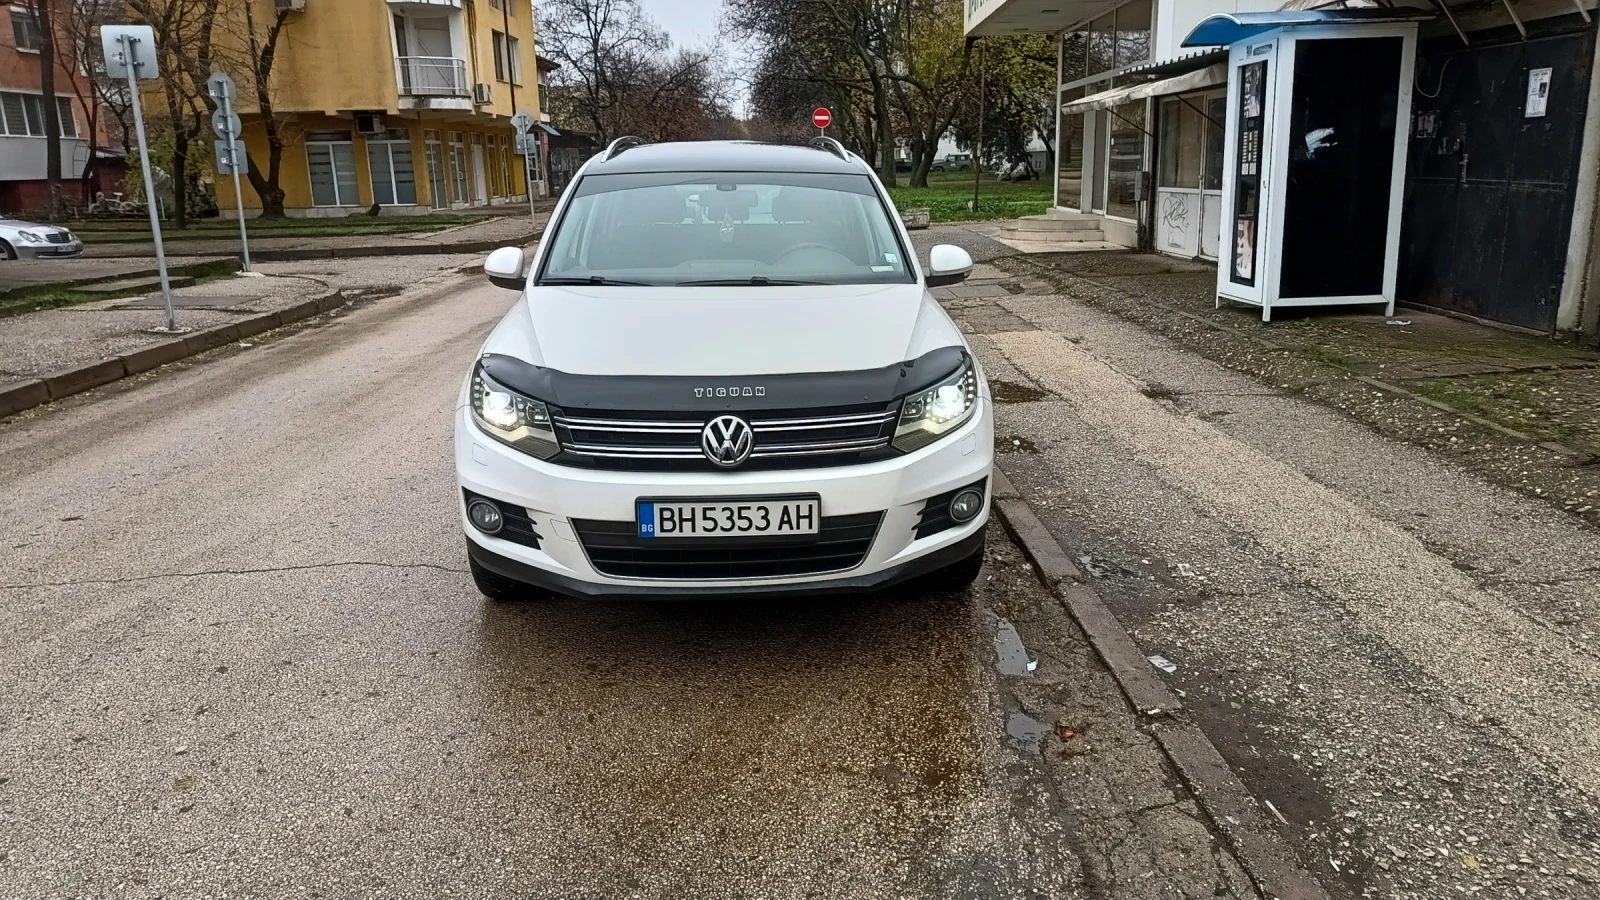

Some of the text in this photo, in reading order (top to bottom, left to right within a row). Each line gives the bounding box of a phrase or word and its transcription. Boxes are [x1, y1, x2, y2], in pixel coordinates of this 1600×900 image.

[694, 386, 766, 398] TIGUAN
[659, 504, 813, 533] BH 5353 AH
[641, 524, 654, 533] BG
